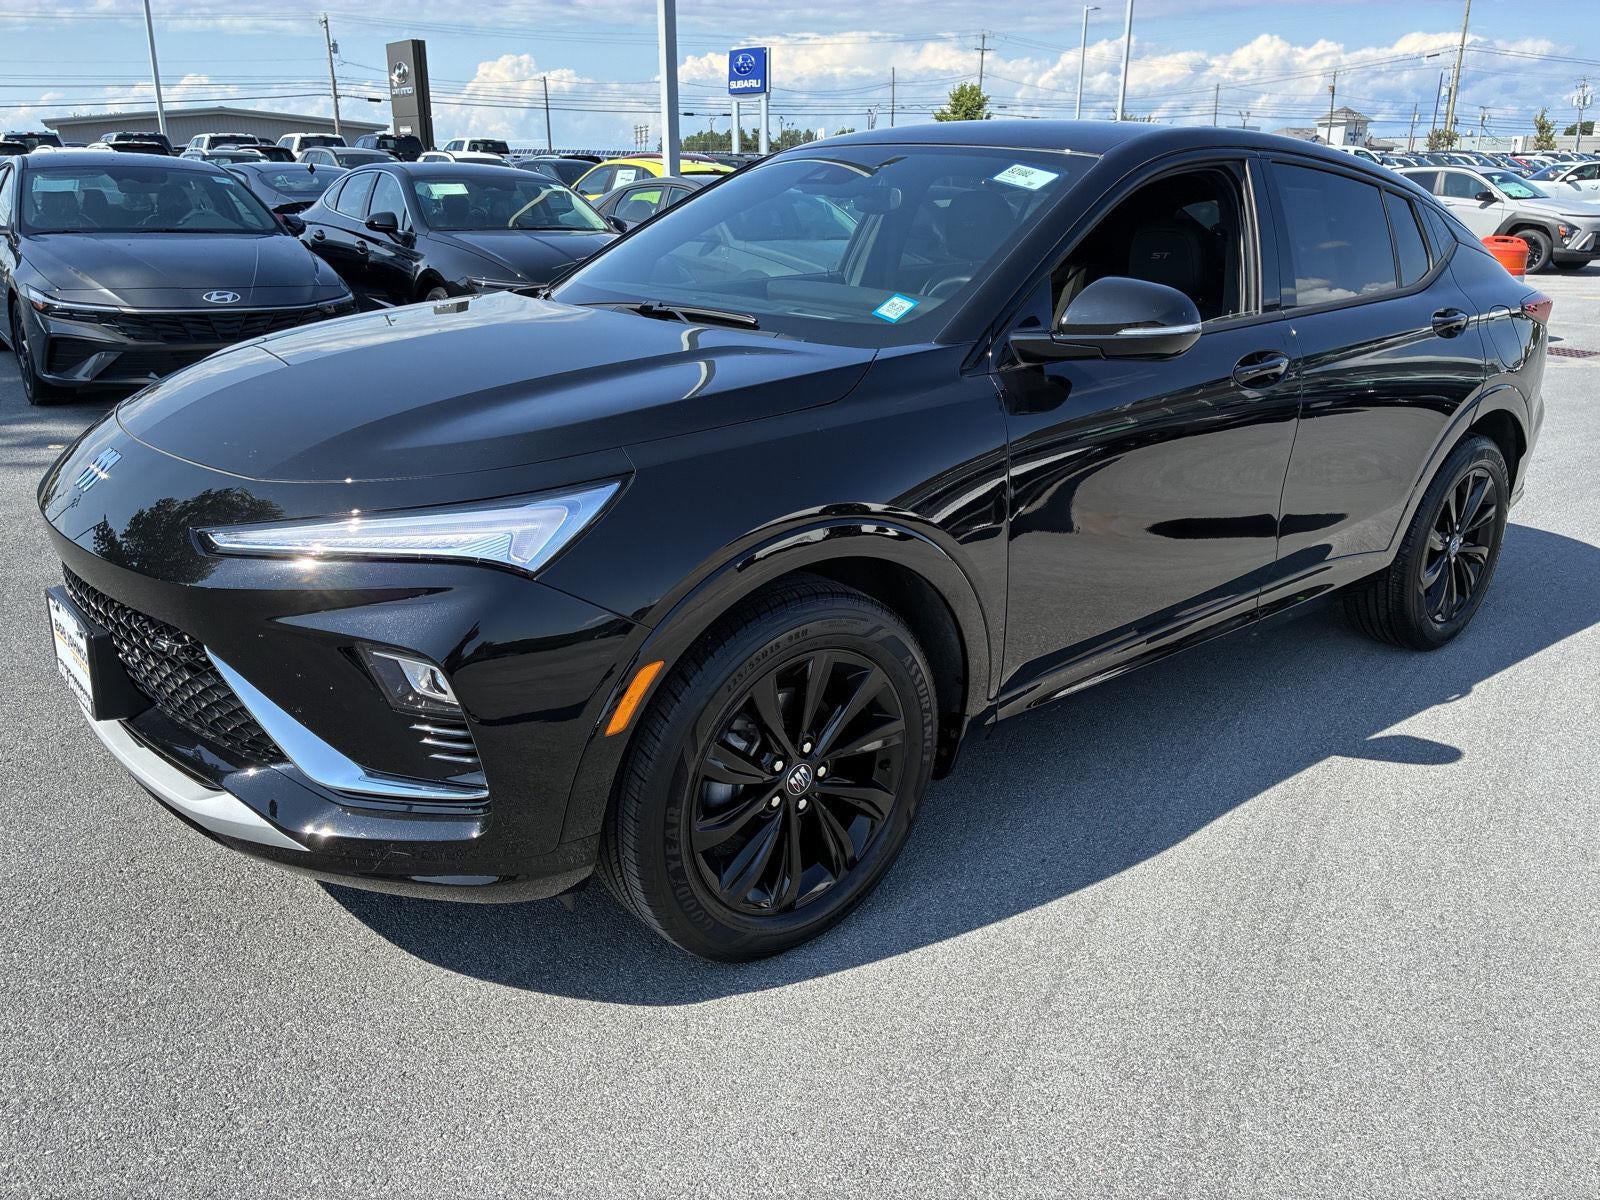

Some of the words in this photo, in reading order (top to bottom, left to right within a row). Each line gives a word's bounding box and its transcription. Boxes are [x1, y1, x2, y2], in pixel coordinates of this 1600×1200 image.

[729, 79, 761, 89] SUBARU
[1150, 251, 1171, 260] ST
[901, 654, 932, 765] ASSURANCE
[664, 806, 715, 931] GOODYEAR
